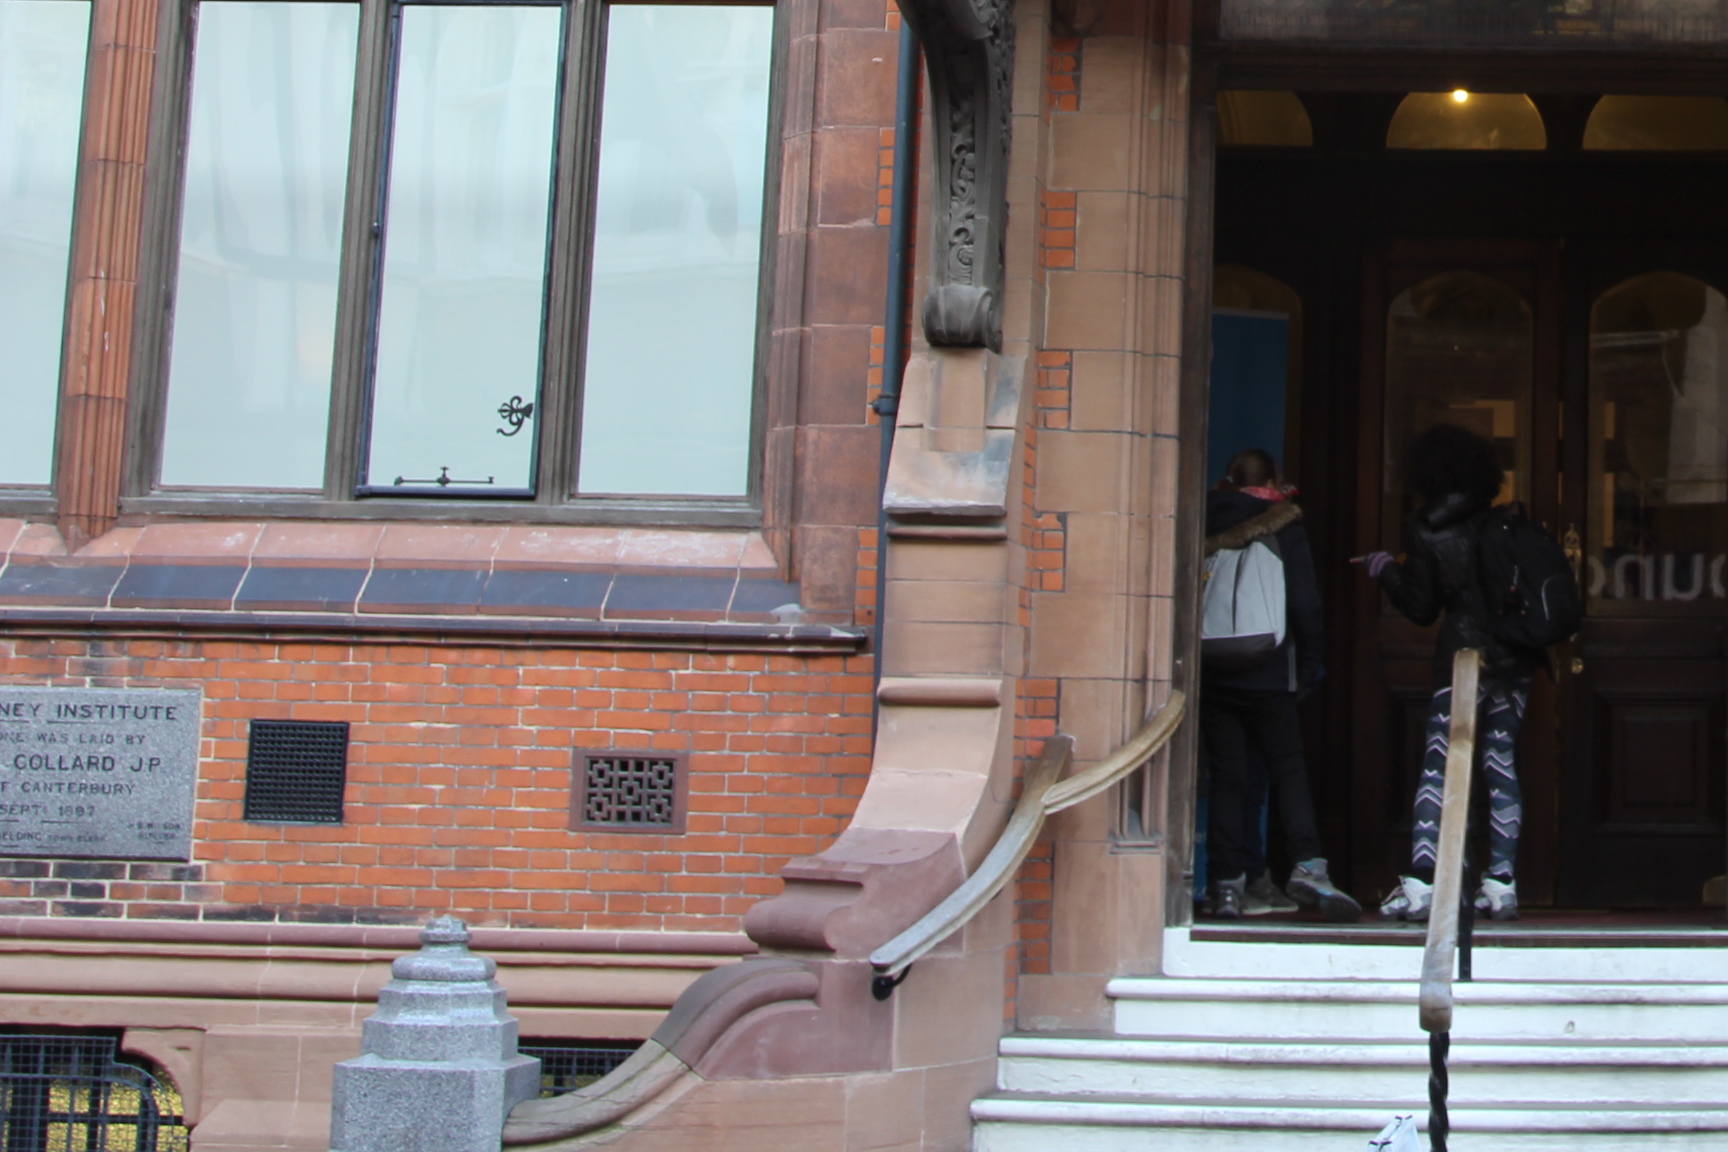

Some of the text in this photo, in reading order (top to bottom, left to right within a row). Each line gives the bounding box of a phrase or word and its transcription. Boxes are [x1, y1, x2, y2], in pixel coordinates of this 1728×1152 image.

[57, 704, 177, 720] INSTITUTE
[37, 733, 68, 744] WAS
[79, 733, 115, 744] LAID
[126, 734, 146, 745] BY
[14, 754, 115, 772] COLLARD
[21, 781, 135, 795] CANTERBURY
[58, 805, 96, 817] 1897
